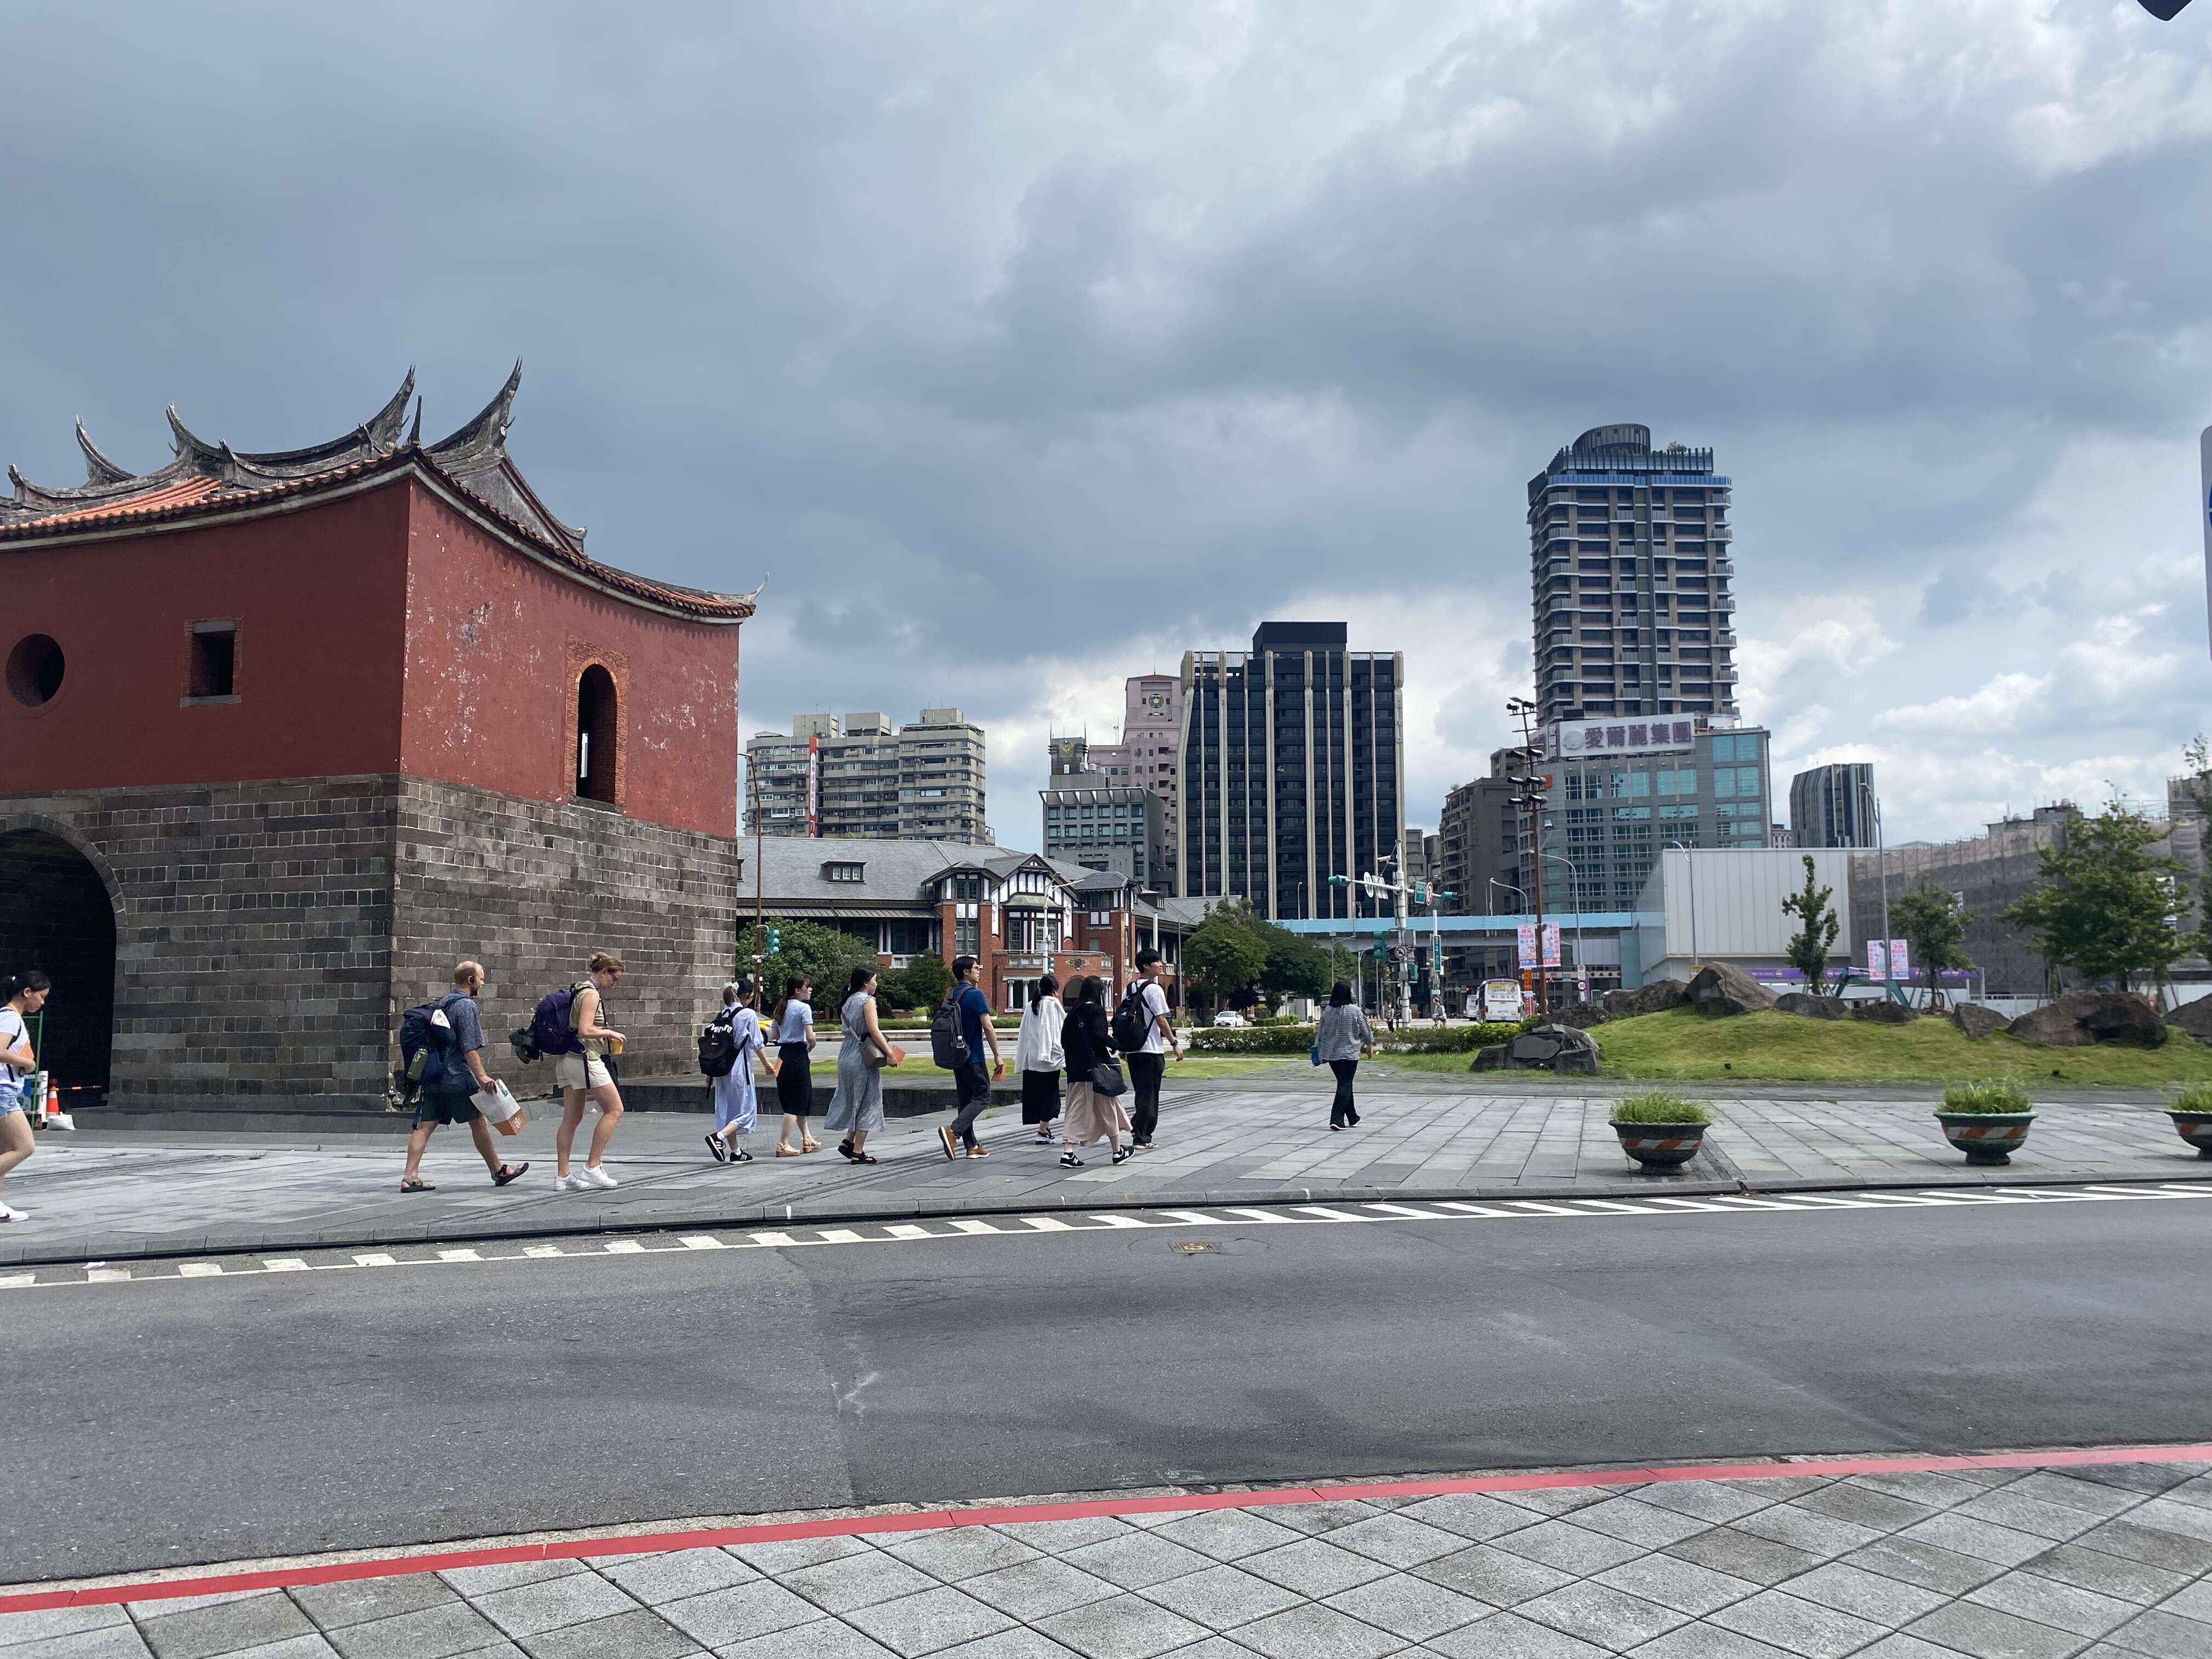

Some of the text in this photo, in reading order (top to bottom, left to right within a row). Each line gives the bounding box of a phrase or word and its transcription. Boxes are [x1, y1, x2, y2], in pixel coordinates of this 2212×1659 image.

[1584, 721, 1692, 748] 愛爾麗集團
